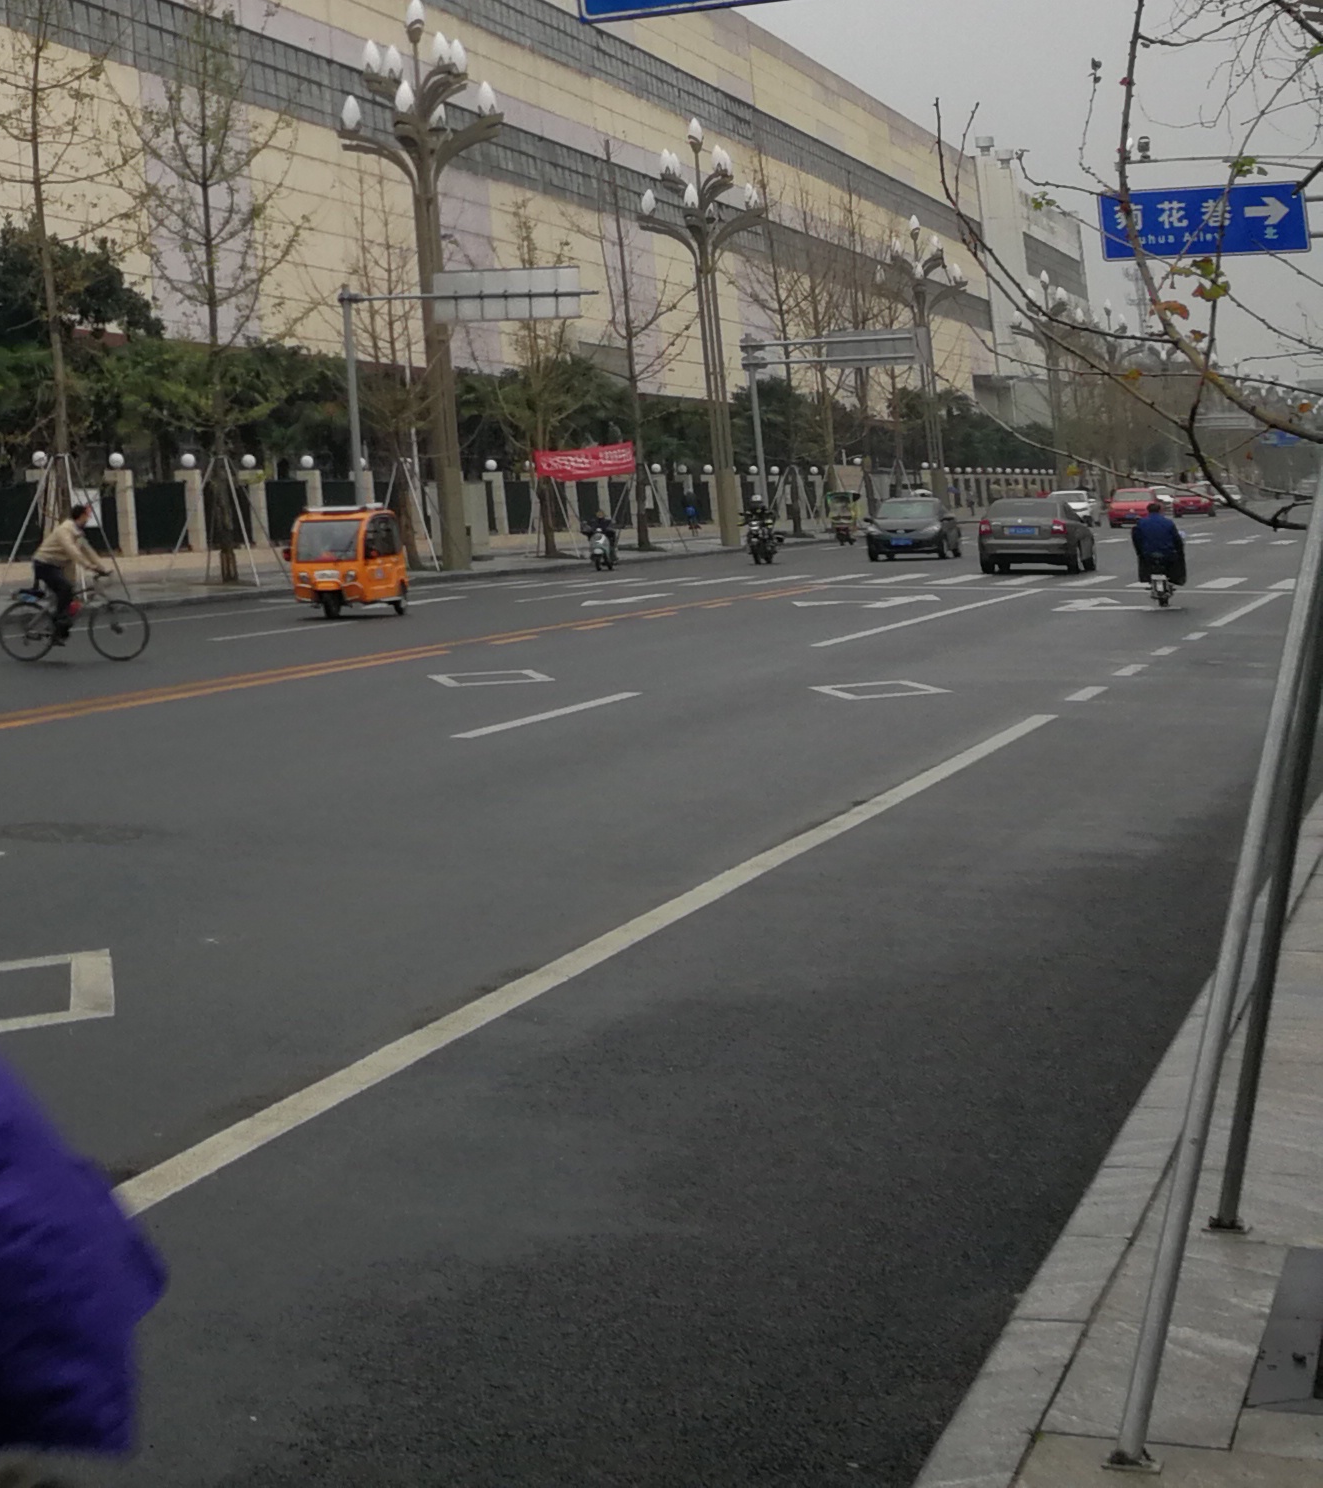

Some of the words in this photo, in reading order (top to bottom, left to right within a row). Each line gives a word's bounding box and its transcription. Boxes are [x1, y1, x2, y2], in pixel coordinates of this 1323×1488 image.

[1114, 198, 1232, 230] 菊花巷
[1129, 234, 1175, 246] uhua
